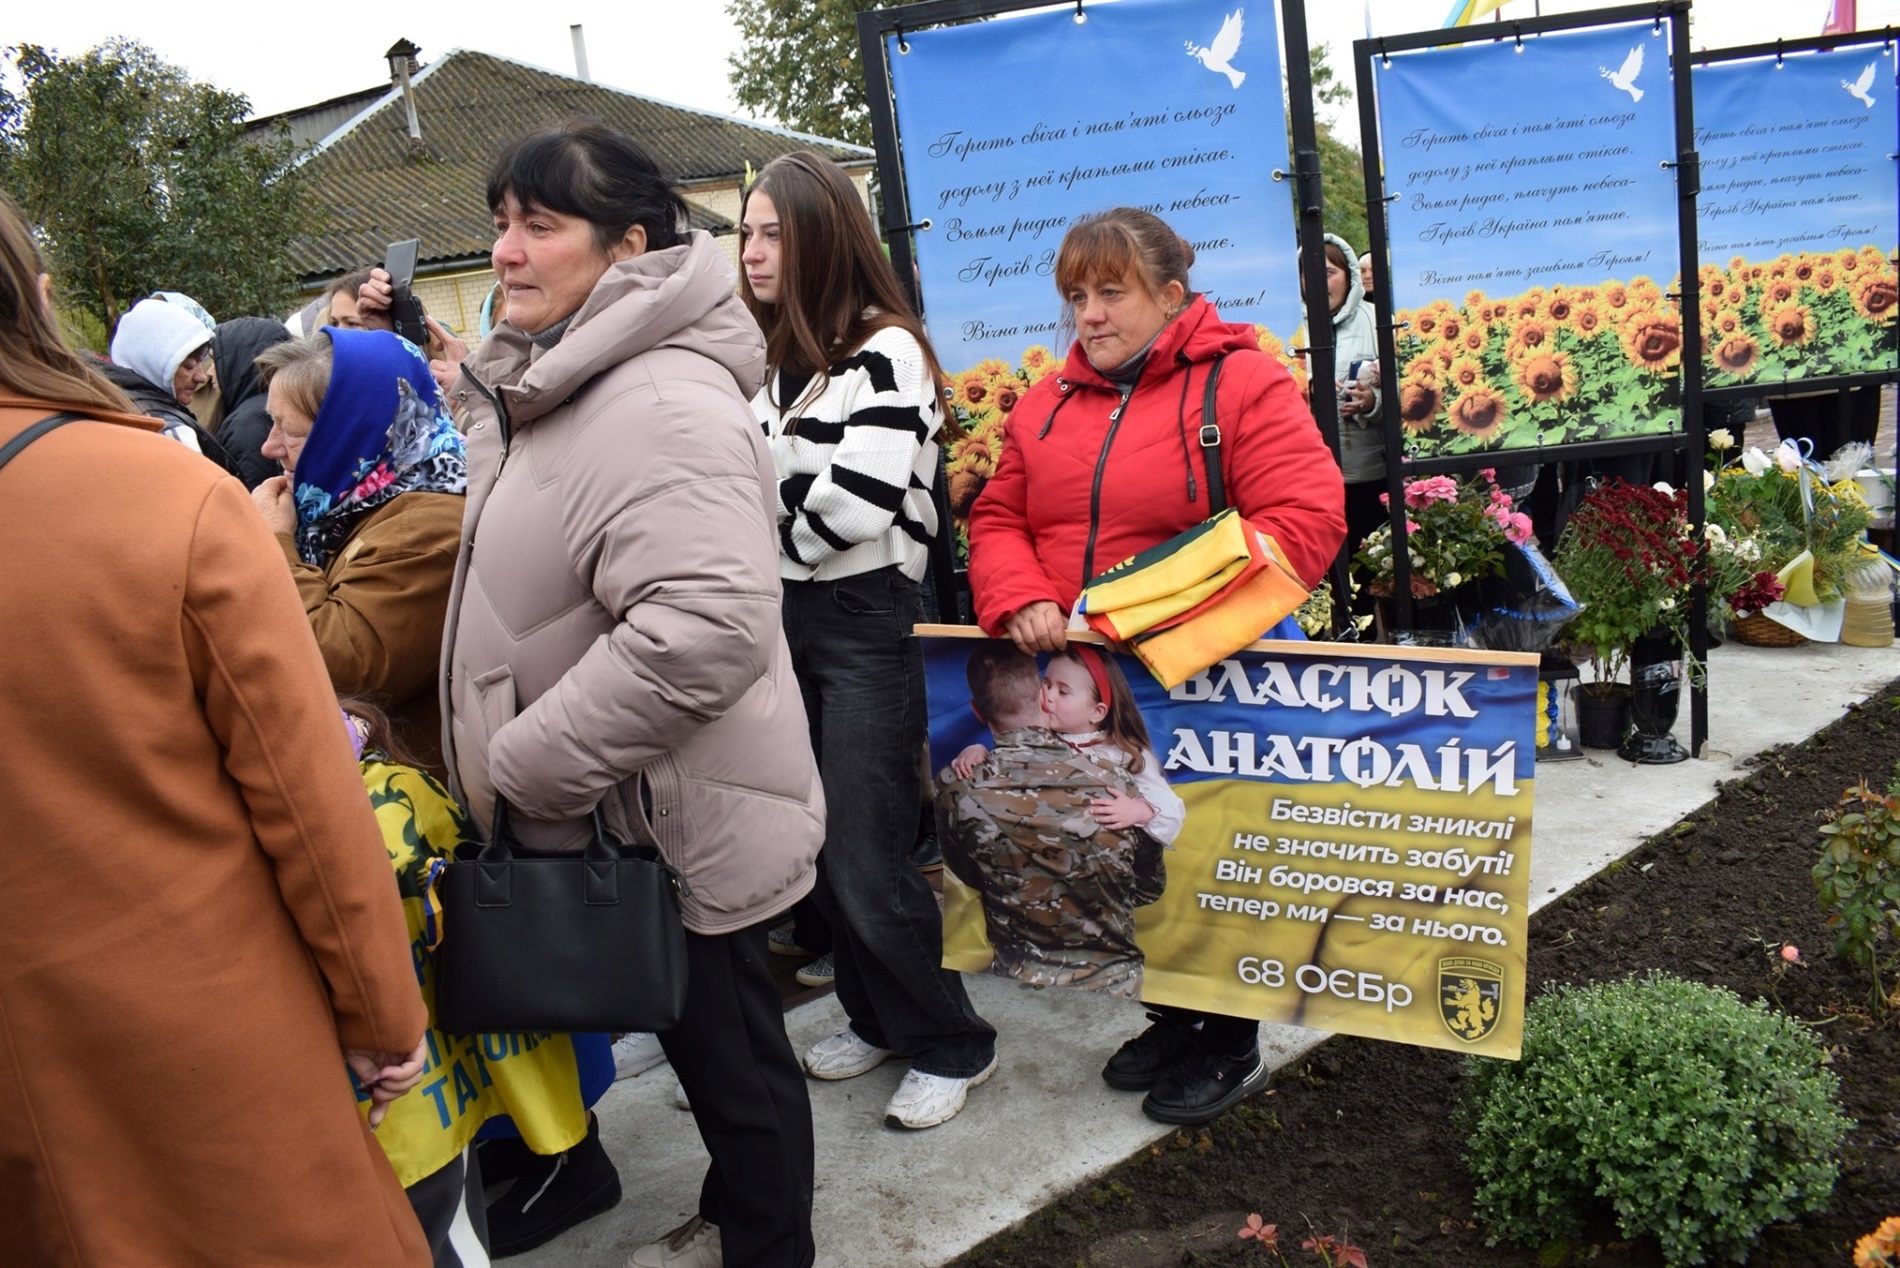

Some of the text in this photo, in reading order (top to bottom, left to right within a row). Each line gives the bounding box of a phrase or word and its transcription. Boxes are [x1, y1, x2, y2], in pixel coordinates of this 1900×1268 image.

[928, 103, 1237, 162] Горить свіча і пам'яті сльоза
[1401, 128, 1469, 152] Горить
[1473, 123, 1507, 139] свіча
[1512, 122, 1519, 135] і
[1589, 112, 1637, 129] сльоза
[1739, 123, 1768, 137] свіча
[1832, 115, 1870, 129] сльоза
[1406, 144, 1634, 187] додолу з неї краплями стікає.
[1729, 157, 1737, 170] з
[1740, 152, 1758, 162] неї
[1760, 146, 1820, 165] краплями
[938, 148, 1234, 210] додолу з неї краплями стікає.
[1410, 193, 1458, 211] Земля
[1459, 193, 1509, 212] ридає,
[1514, 184, 1578, 202] плачуть
[1770, 173, 1822, 187] плачуть
[1696, 201, 1741, 220] Героїв
[1742, 197, 1797, 216] Україна
[943, 217, 1007, 242] Земля
[1008, 216, 1072, 241] ридає,
[1418, 221, 1477, 245] Героїв
[1478, 216, 1548, 238] Україна
[958, 254, 1032, 287] Героїв
[1419, 270, 1462, 286] Вічна
[1524, 258, 1585, 281] загиблим
[1587, 250, 1651, 271] Героям!
[961, 320, 1018, 342] Вічна
[1169, 659, 1479, 718] ВЛАСЮК
[1163, 728, 1521, 797] АНАТОЛІЙ
[1270, 798, 1516, 840] Безвісти зниклі
[1233, 832, 1514, 877] не значить забуті!
[1215, 859, 1509, 915] Він боровся за нас,
[1196, 892, 1280, 920] тепер
[1286, 903, 1329, 923] ми
[1369, 912, 1405, 932] за
[1411, 918, 1507, 946] нього.
[1237, 956, 1413, 1012] 68 ОЄБр
